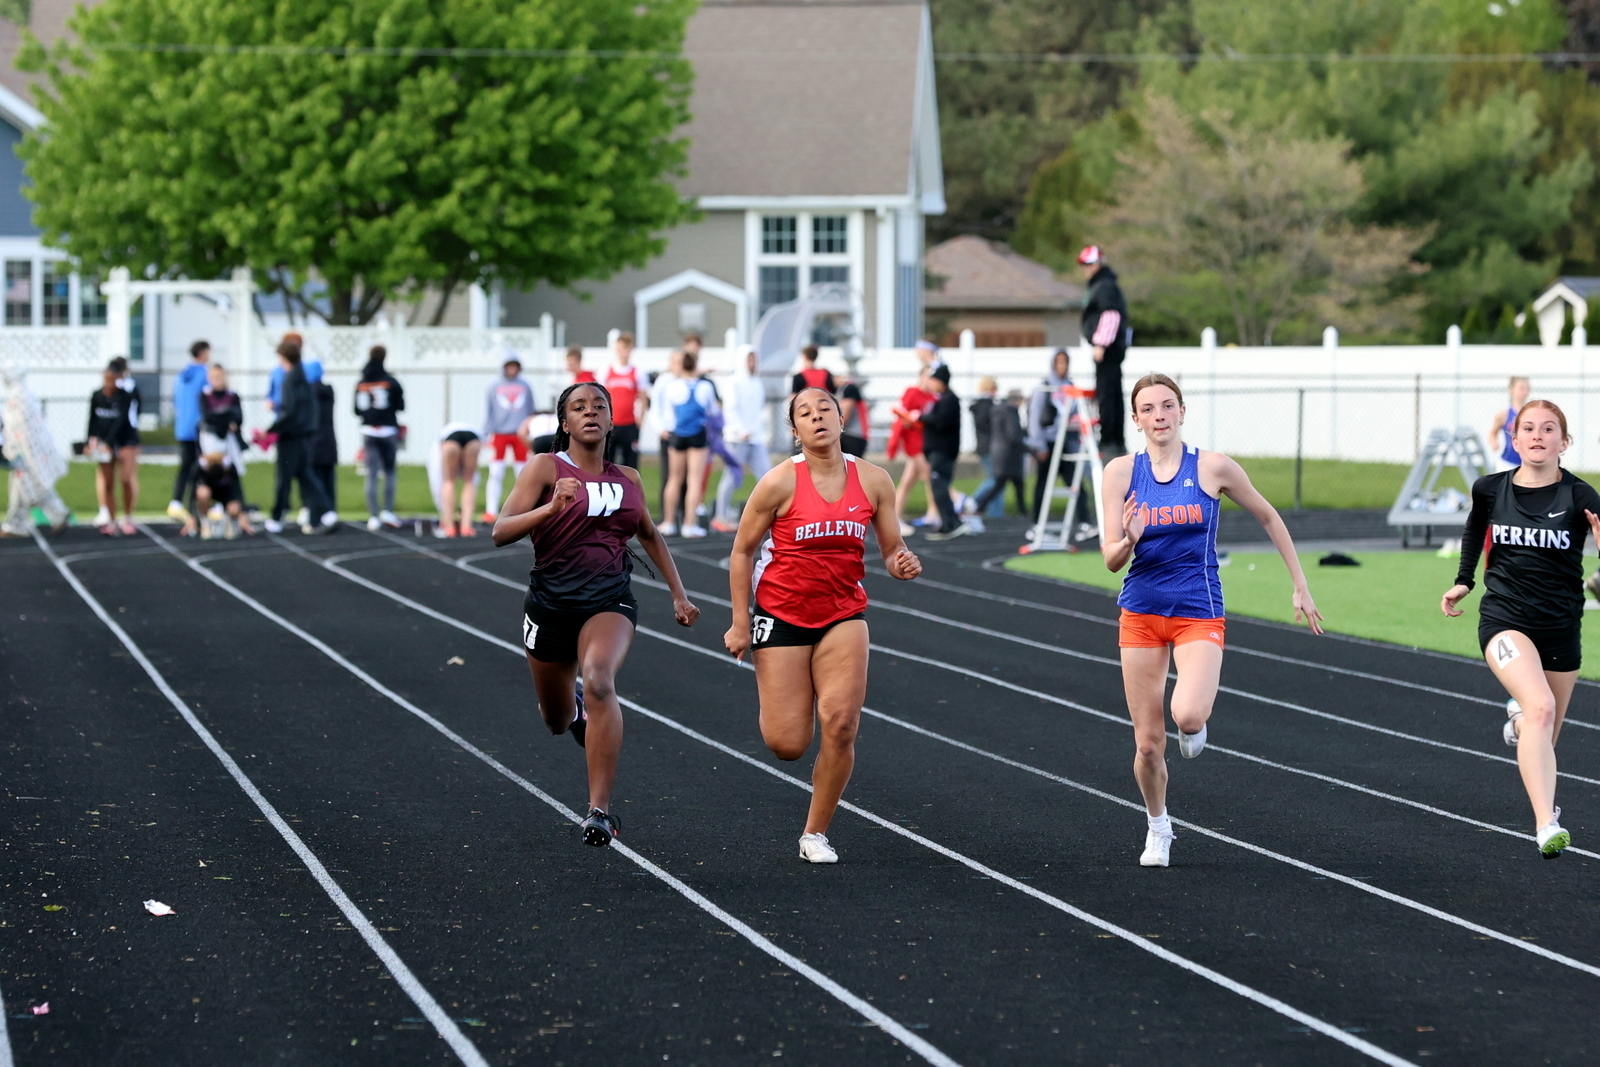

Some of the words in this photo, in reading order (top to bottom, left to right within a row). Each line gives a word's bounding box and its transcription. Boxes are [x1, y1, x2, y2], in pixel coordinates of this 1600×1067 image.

[585, 480, 624, 517] W
[1132, 503, 1203, 527] DISON
[795, 520, 866, 541] BELLEVUE
[1492, 524, 1571, 550] PERKINS
[1498, 638, 1514, 662] 4
